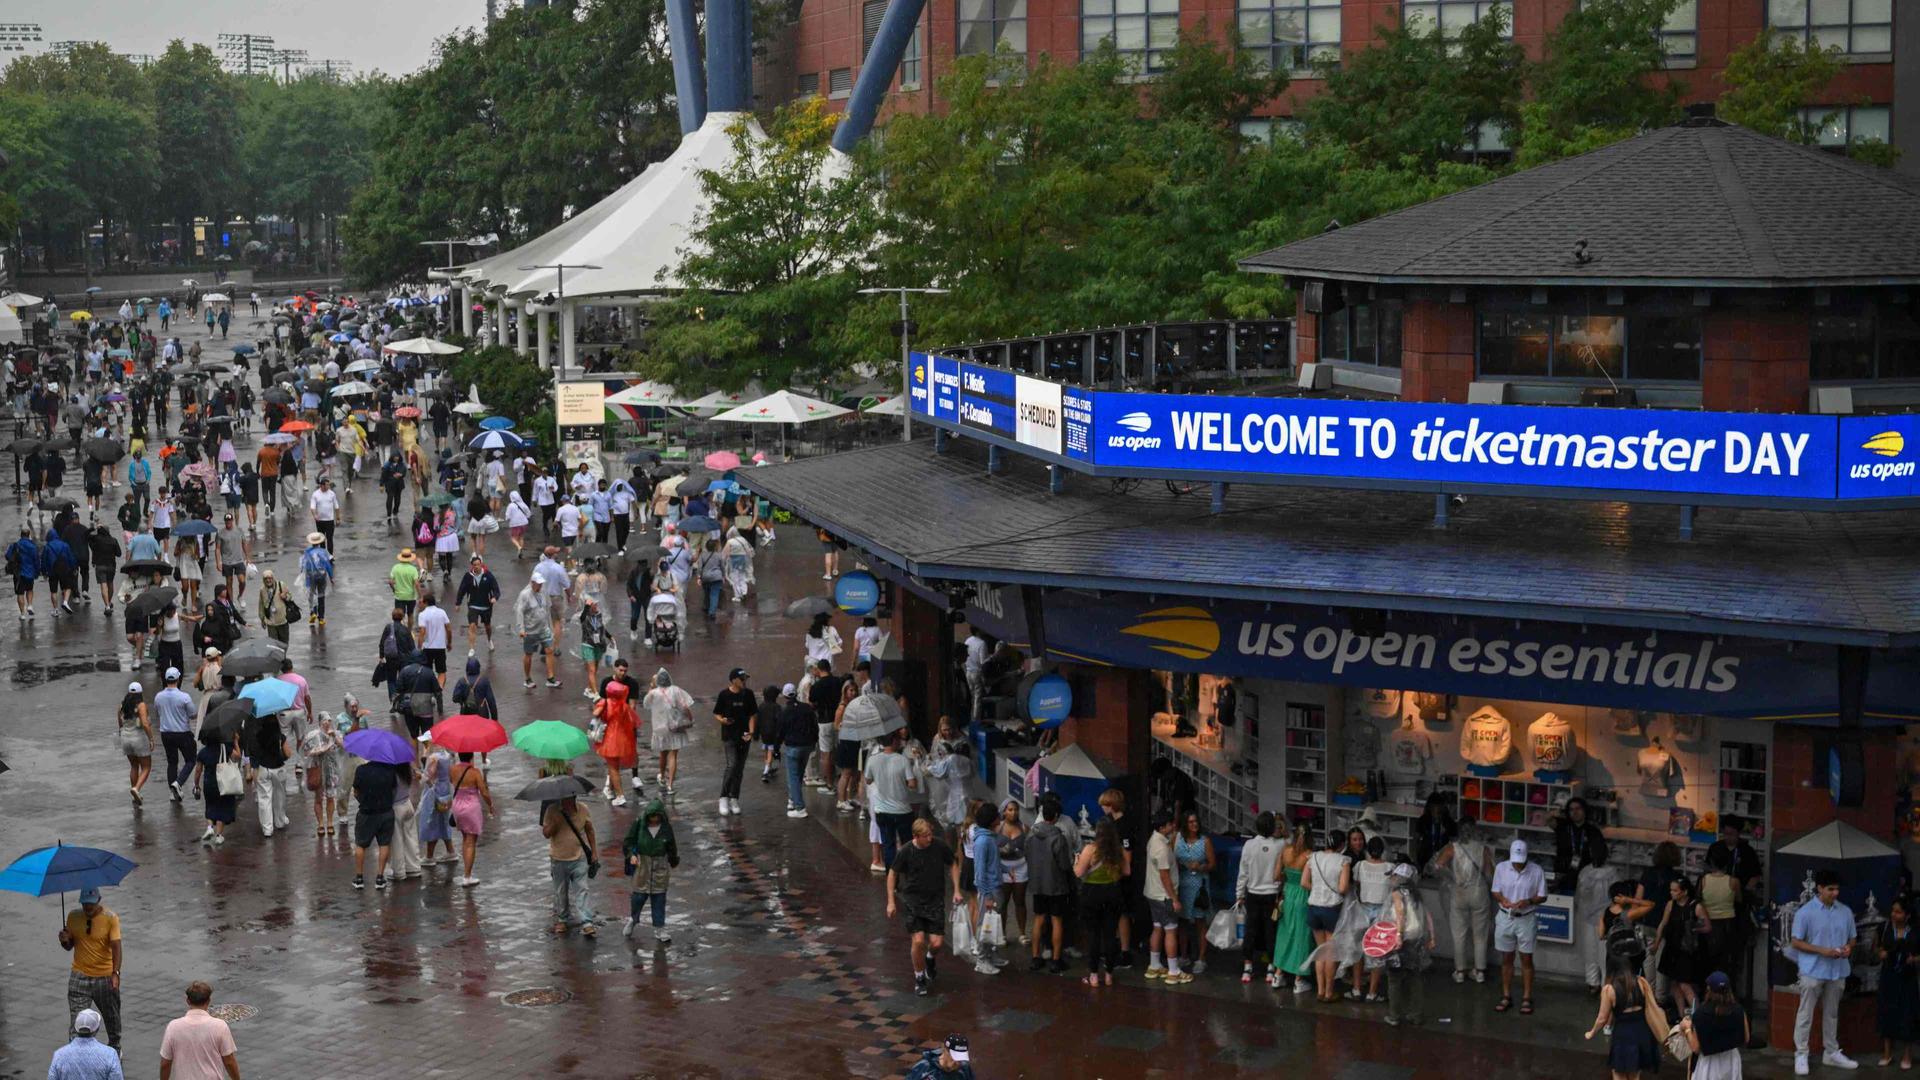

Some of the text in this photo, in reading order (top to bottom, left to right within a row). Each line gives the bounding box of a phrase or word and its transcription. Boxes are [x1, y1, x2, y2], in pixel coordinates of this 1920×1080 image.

[1020, 402, 1057, 429] SCHEDULED
[1063, 395, 1077, 408] SCORES
[1080, 399, 1092, 412] STATS
[1067, 422, 1088, 453] IBM
[1108, 436, 1161, 453] us open
[1170, 411, 1810, 476] WELCOME TO ticketmaster DAY
[1850, 461, 1915, 482] us open
[1237, 621, 1741, 693] us open essentials
